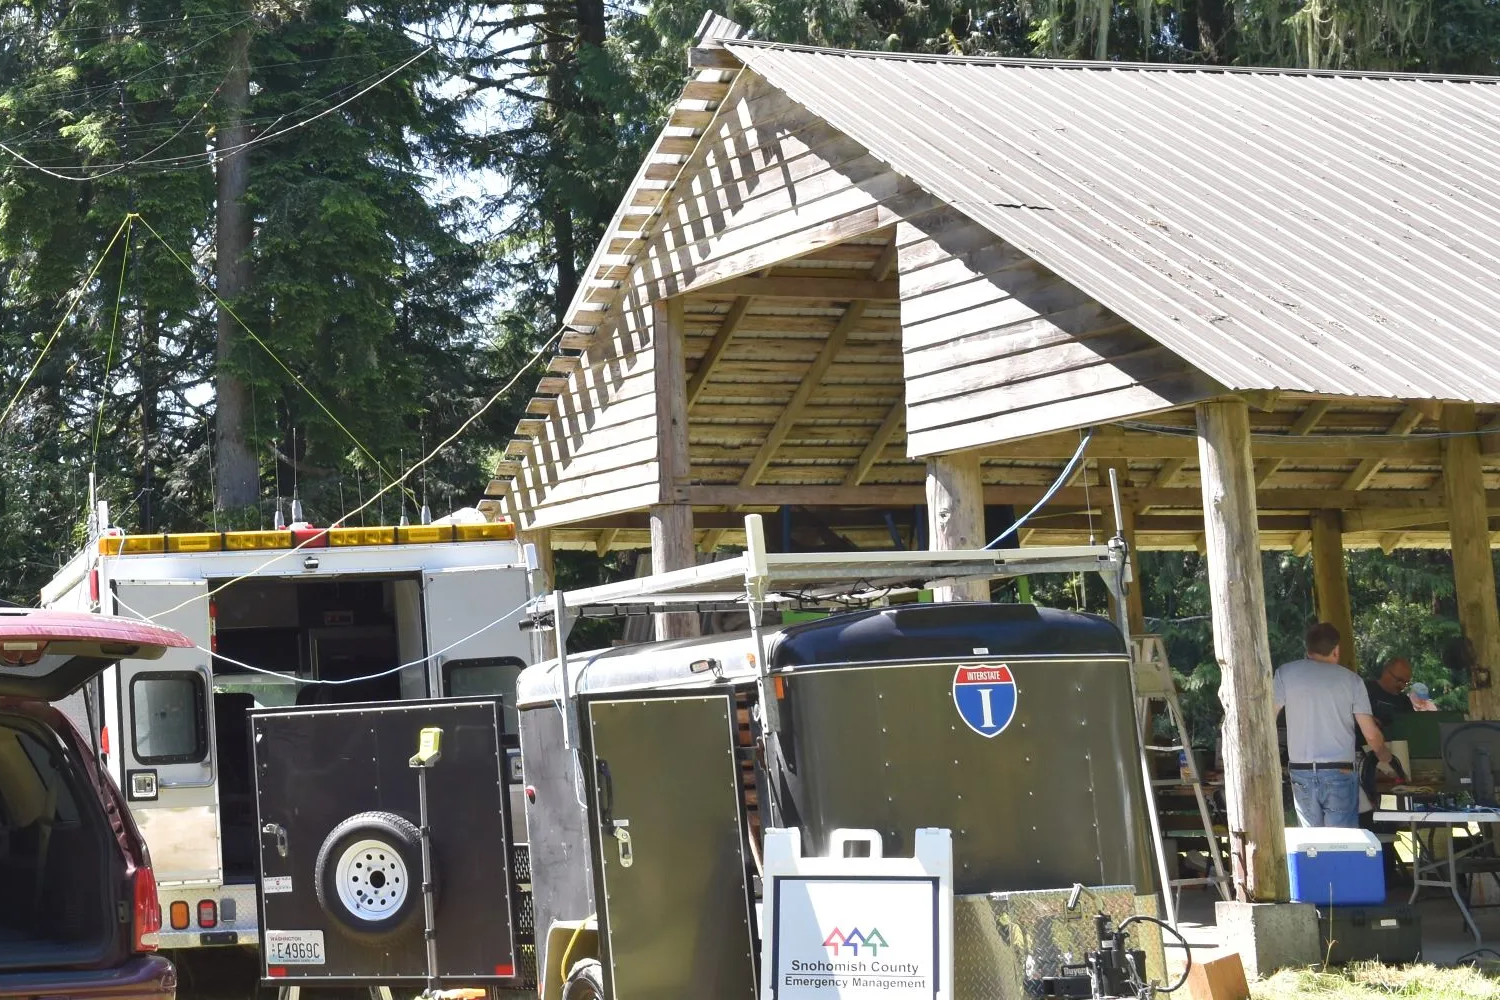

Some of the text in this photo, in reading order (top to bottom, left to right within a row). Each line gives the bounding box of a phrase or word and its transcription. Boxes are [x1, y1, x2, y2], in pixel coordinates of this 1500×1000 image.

[967, 671, 1001, 680] INTERSTATE
[277, 942, 320, 959] E4969C
[791, 960, 919, 976] Snohomish County
[785, 976, 926, 990] Emergency Management
